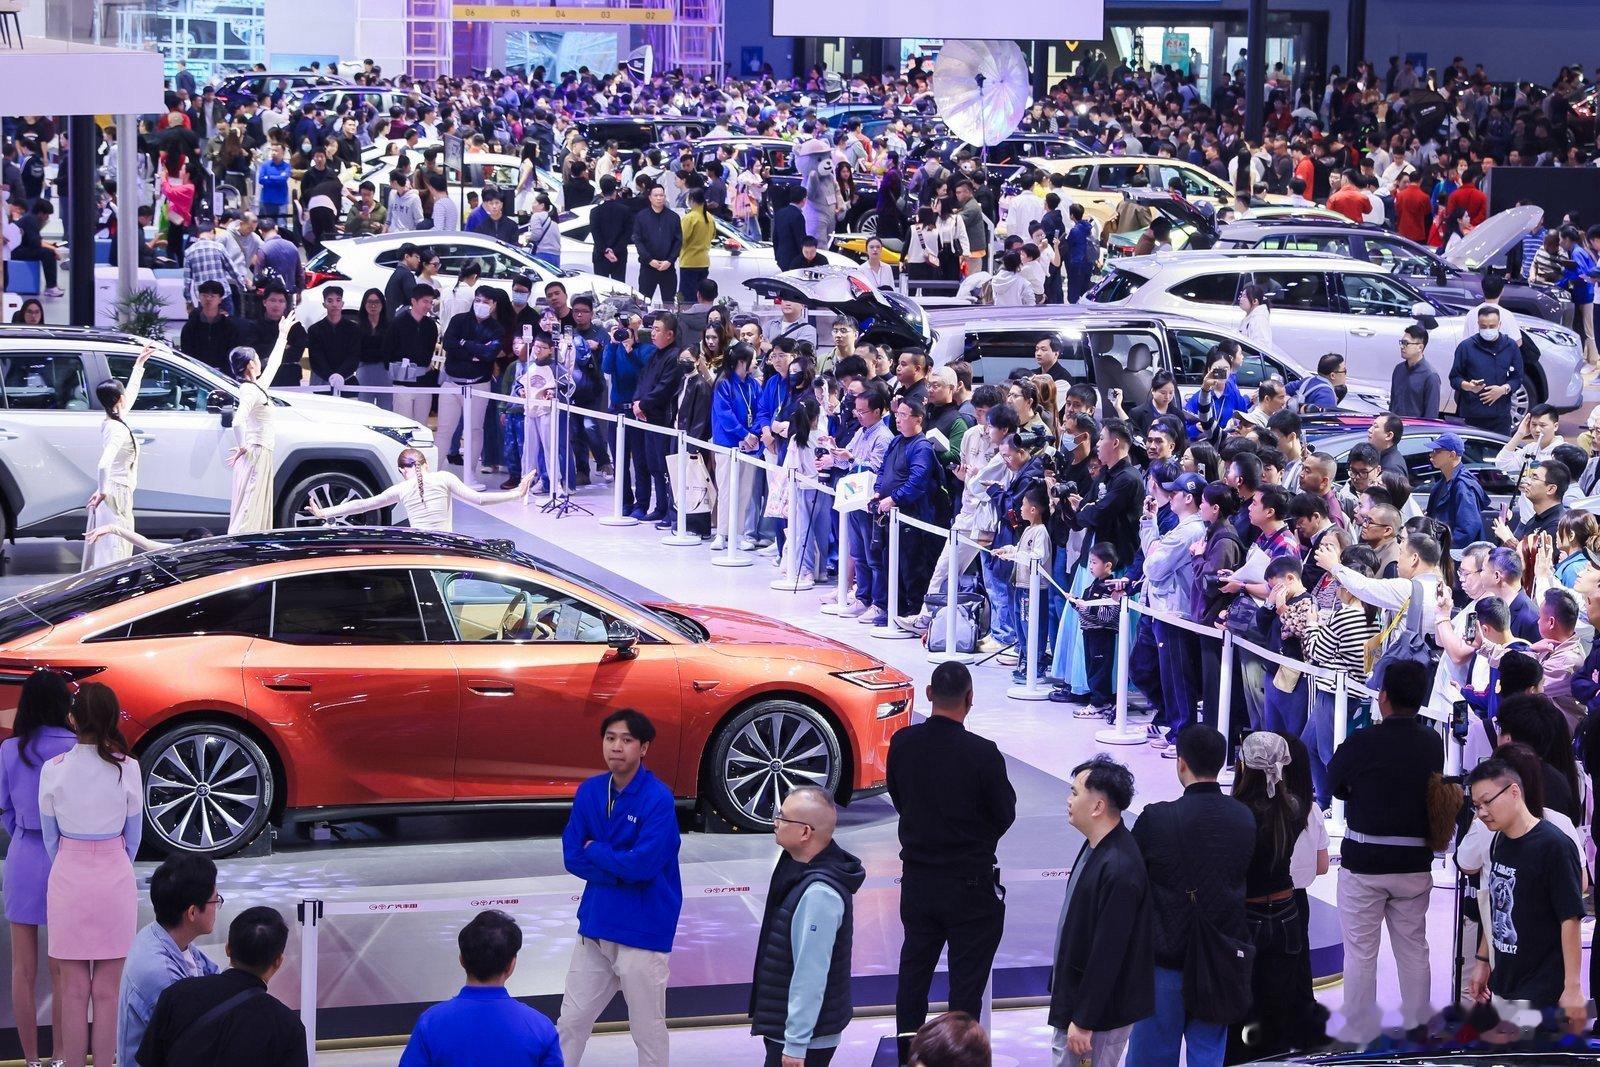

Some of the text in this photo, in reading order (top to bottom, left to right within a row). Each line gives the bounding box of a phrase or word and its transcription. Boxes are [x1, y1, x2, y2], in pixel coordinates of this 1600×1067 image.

[465, 8, 656, 20] 06 05 04 03 02
[488, 898, 519, 906] 广汽丰田
